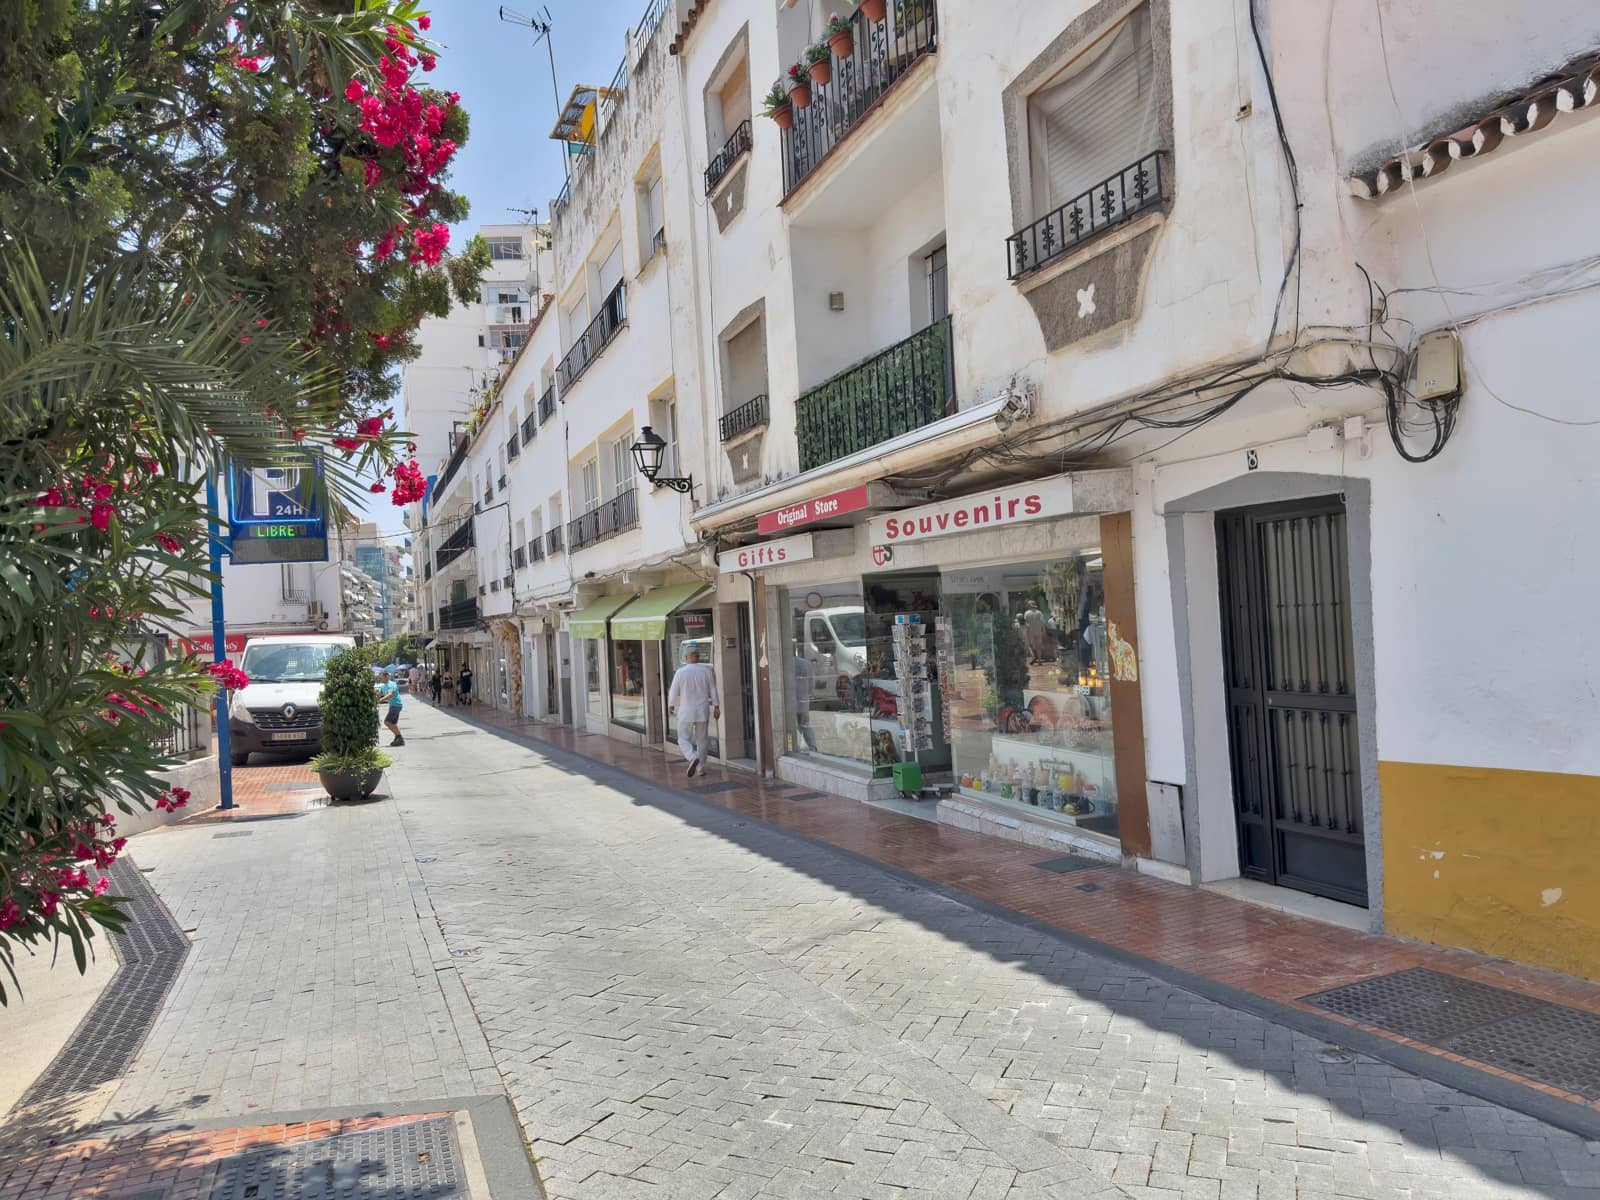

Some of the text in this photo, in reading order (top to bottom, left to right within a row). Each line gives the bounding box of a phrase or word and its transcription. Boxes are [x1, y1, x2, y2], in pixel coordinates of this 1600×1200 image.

[251, 462, 301, 516] P
[275, 504, 302, 516] 24H
[777, 498, 838, 525] Original Store
[886, 494, 1042, 540] Souvenirs
[257, 525, 295, 537] LIBRE
[738, 547, 786, 567] Gifts
